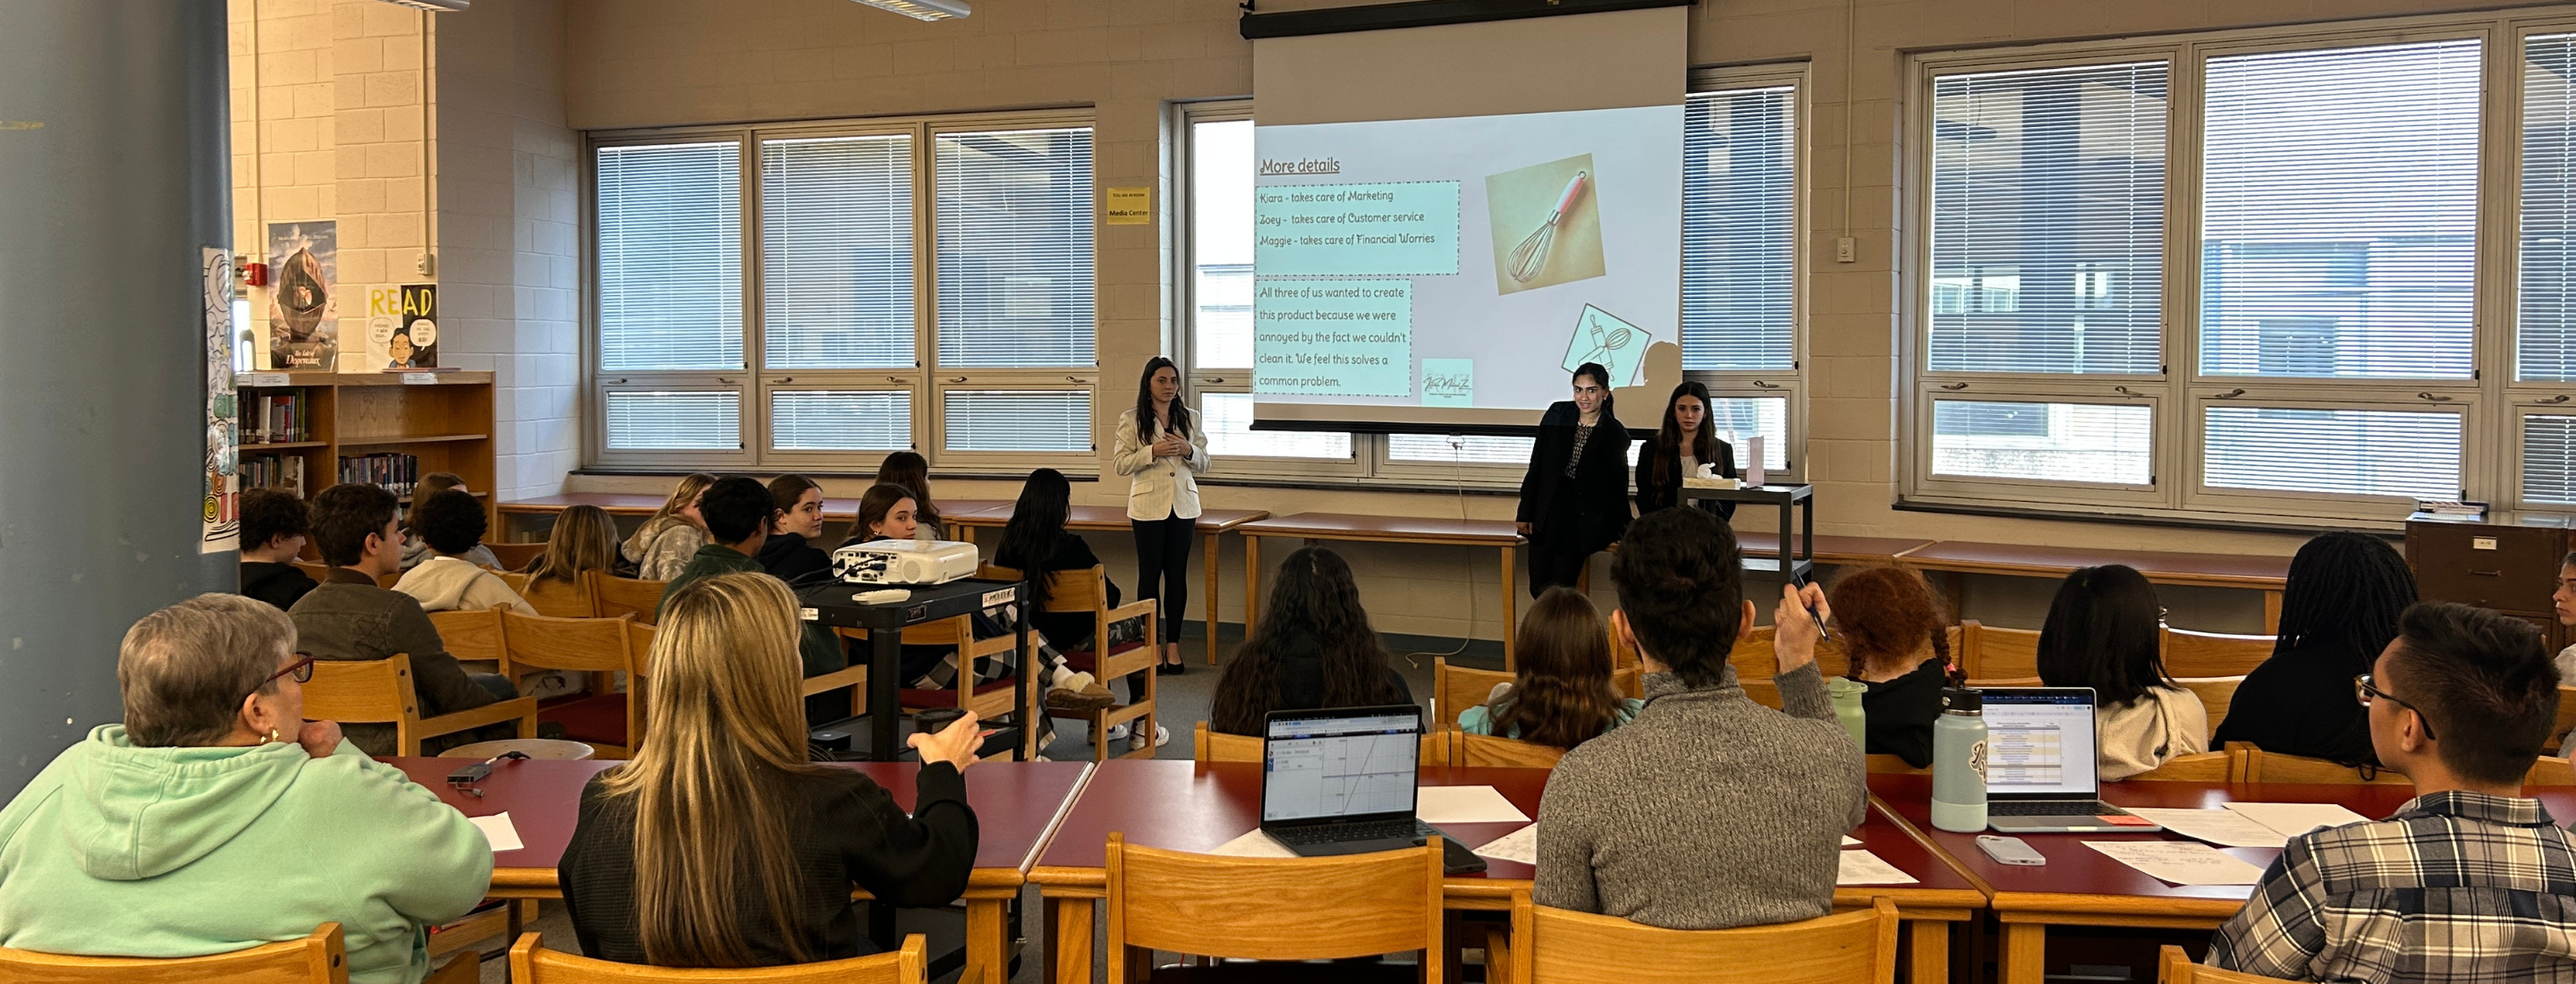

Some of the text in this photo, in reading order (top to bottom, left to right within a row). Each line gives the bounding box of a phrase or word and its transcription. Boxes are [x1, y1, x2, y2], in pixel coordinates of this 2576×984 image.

[1259, 157, 1341, 174] More details
[1259, 193, 1283, 203] Kiara
[1291, 191, 1314, 202] takes
[1316, 192, 1335, 202] care
[1336, 191, 1346, 203] of
[1347, 190, 1394, 203] Marketing
[1259, 214, 1281, 226] Zoey
[1292, 213, 1314, 225] takes
[1316, 215, 1335, 224] care
[1336, 213, 1346, 225] of
[1347, 212, 1392, 224] Customer
[1393, 211, 1425, 223] service
[1259, 235, 1292, 248] Maggie
[1300, 234, 1323, 246] takes
[1324, 235, 1343, 245] care
[1345, 233, 1355, 246] of
[1356, 233, 1397, 245] Financial
[1399, 233, 1436, 244] Worries
[1259, 286, 1404, 299] All three of us wanted to create
[370, 288, 432, 317] READ
[1259, 310, 1396, 322] this product because we were
[1259, 331, 1406, 344] annoyed by the fact we couldn't
[1259, 352, 1388, 365] clean it. We feel this solves a
[1259, 376, 1341, 388] common problem.
